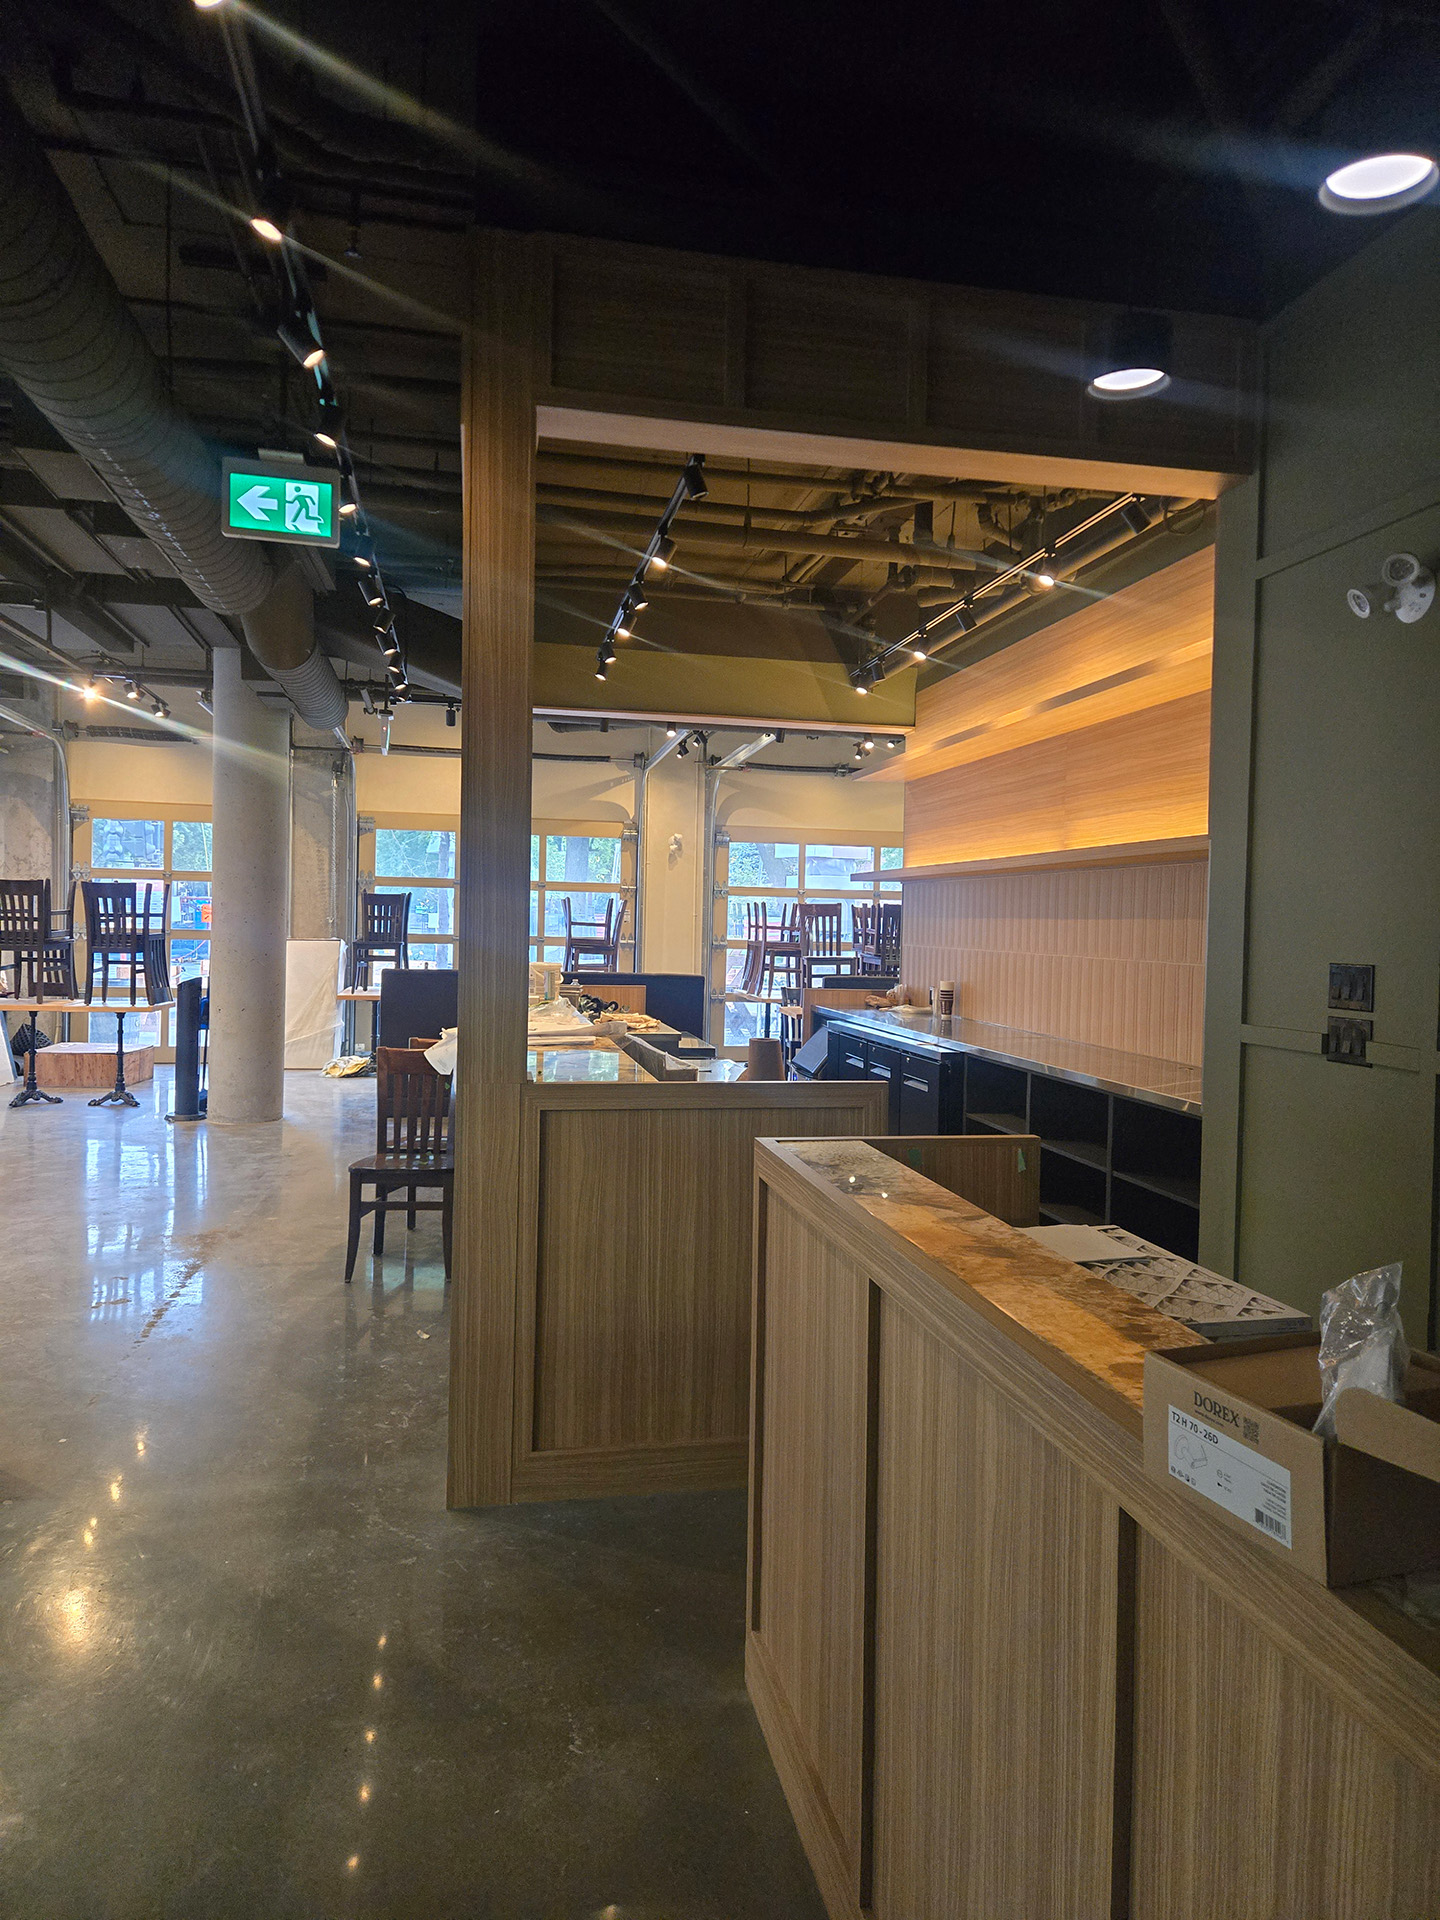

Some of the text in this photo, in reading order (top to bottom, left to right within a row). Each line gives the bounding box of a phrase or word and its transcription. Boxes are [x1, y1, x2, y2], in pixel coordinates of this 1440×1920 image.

[1171, 1410, 1181, 1424] T2
[1181, 1416, 1188, 1428] H
[1189, 1420, 1199, 1434] 70
[1203, 1428, 1219, 1445] 26D
[1194, 1391, 1239, 1428] DOREX
